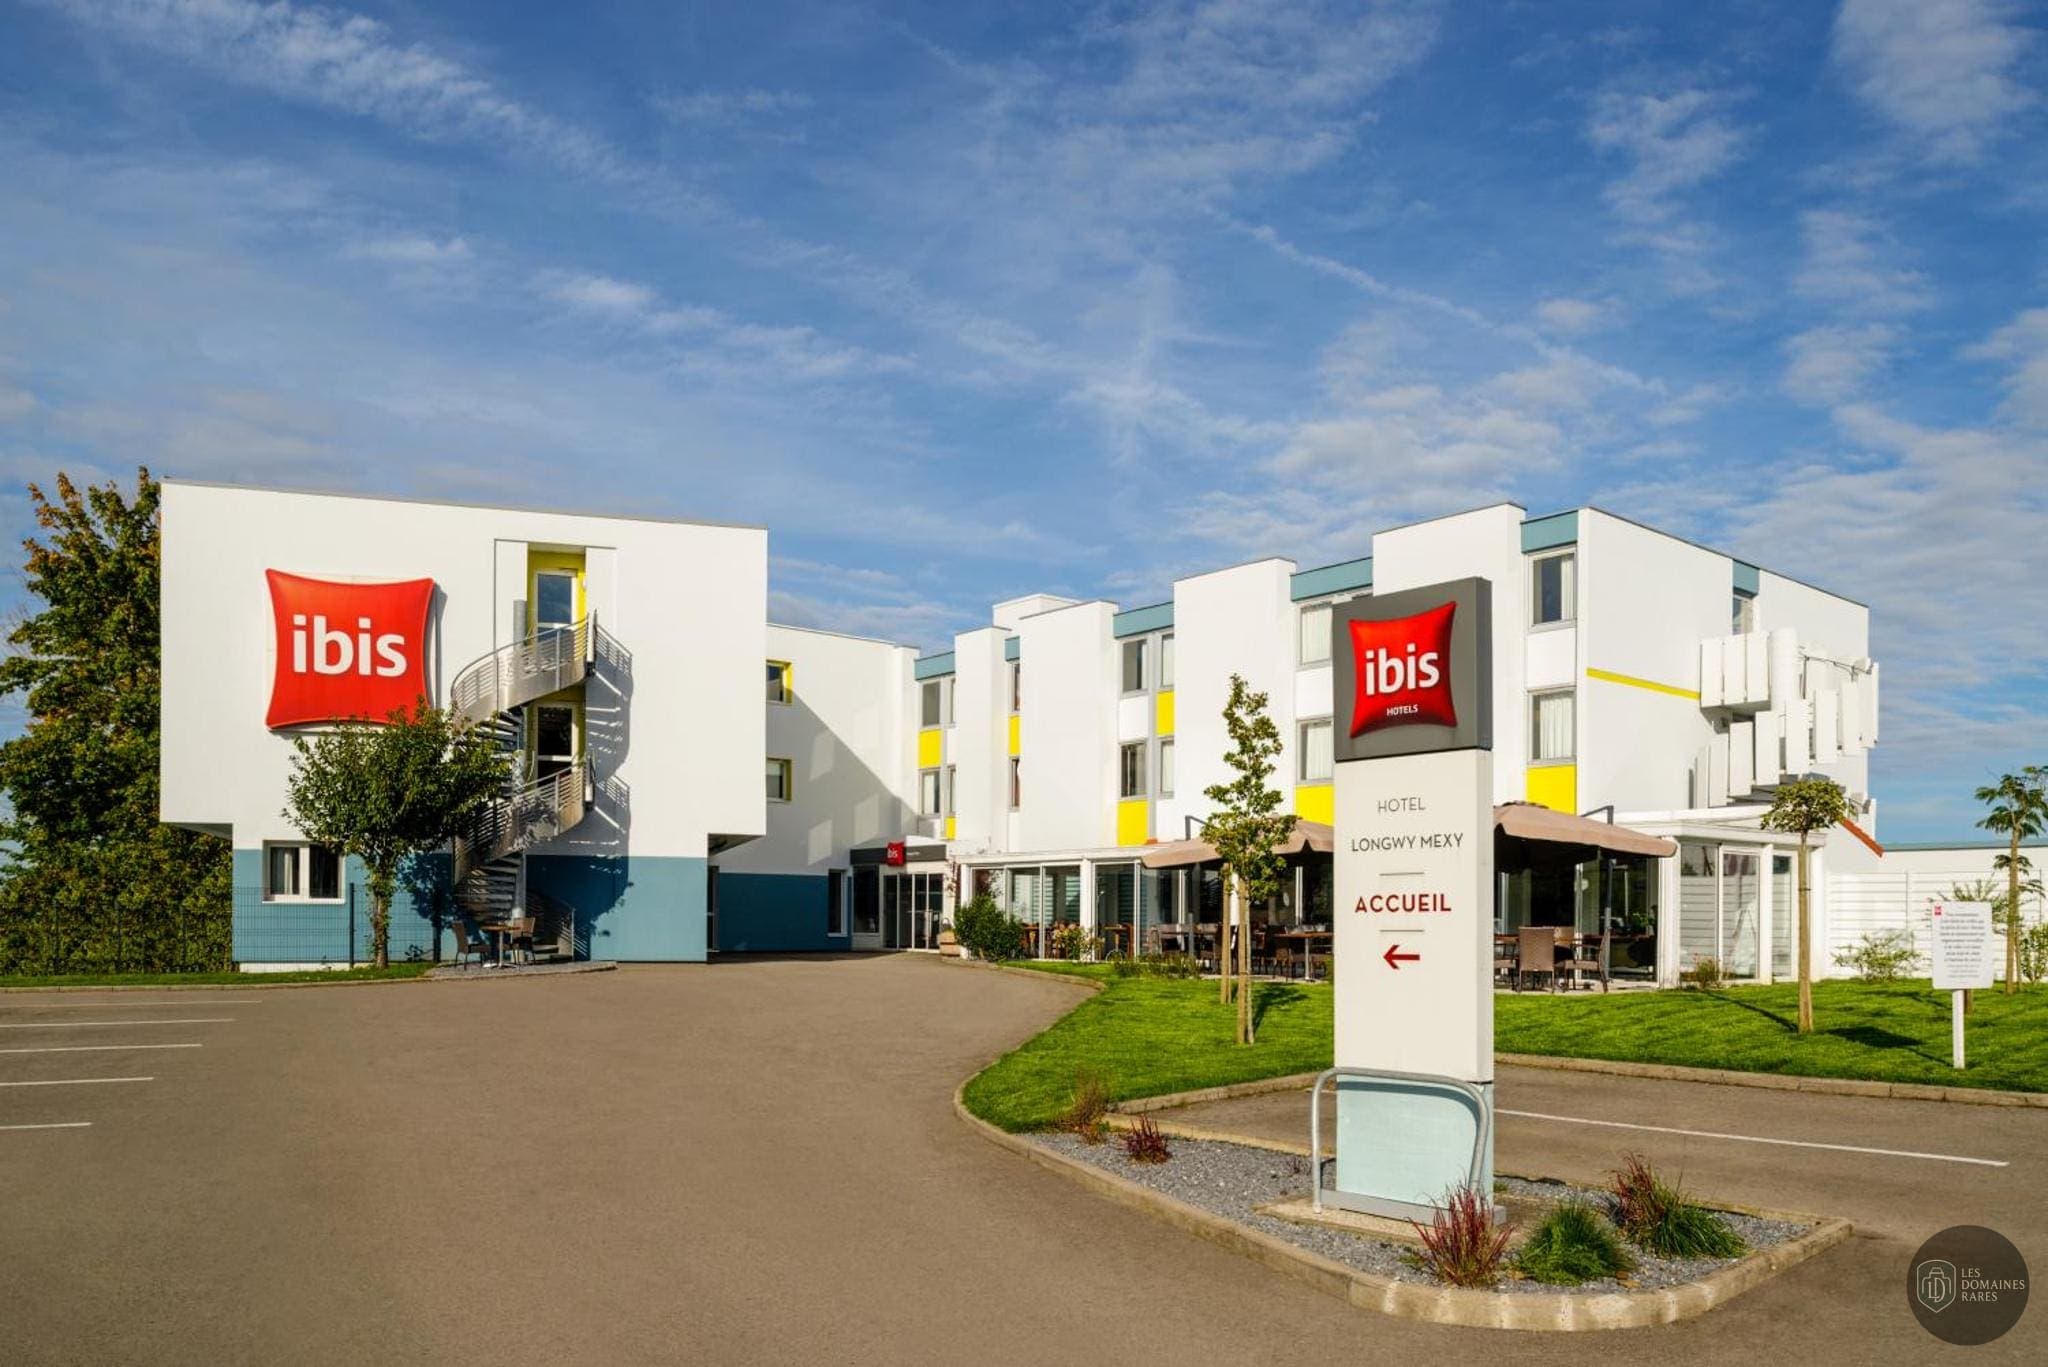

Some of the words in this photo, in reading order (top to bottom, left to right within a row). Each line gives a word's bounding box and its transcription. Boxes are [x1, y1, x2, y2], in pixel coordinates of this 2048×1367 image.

[293, 614, 408, 678] ibis
[1365, 642, 1440, 696] ibis
[1386, 703, 1419, 717] HOTELS
[1377, 797, 1427, 815] HOTEL
[1351, 836, 1416, 852] LONGWY
[1420, 832, 1464, 849] MEXY
[1355, 893, 1452, 914] ACCUEIL
